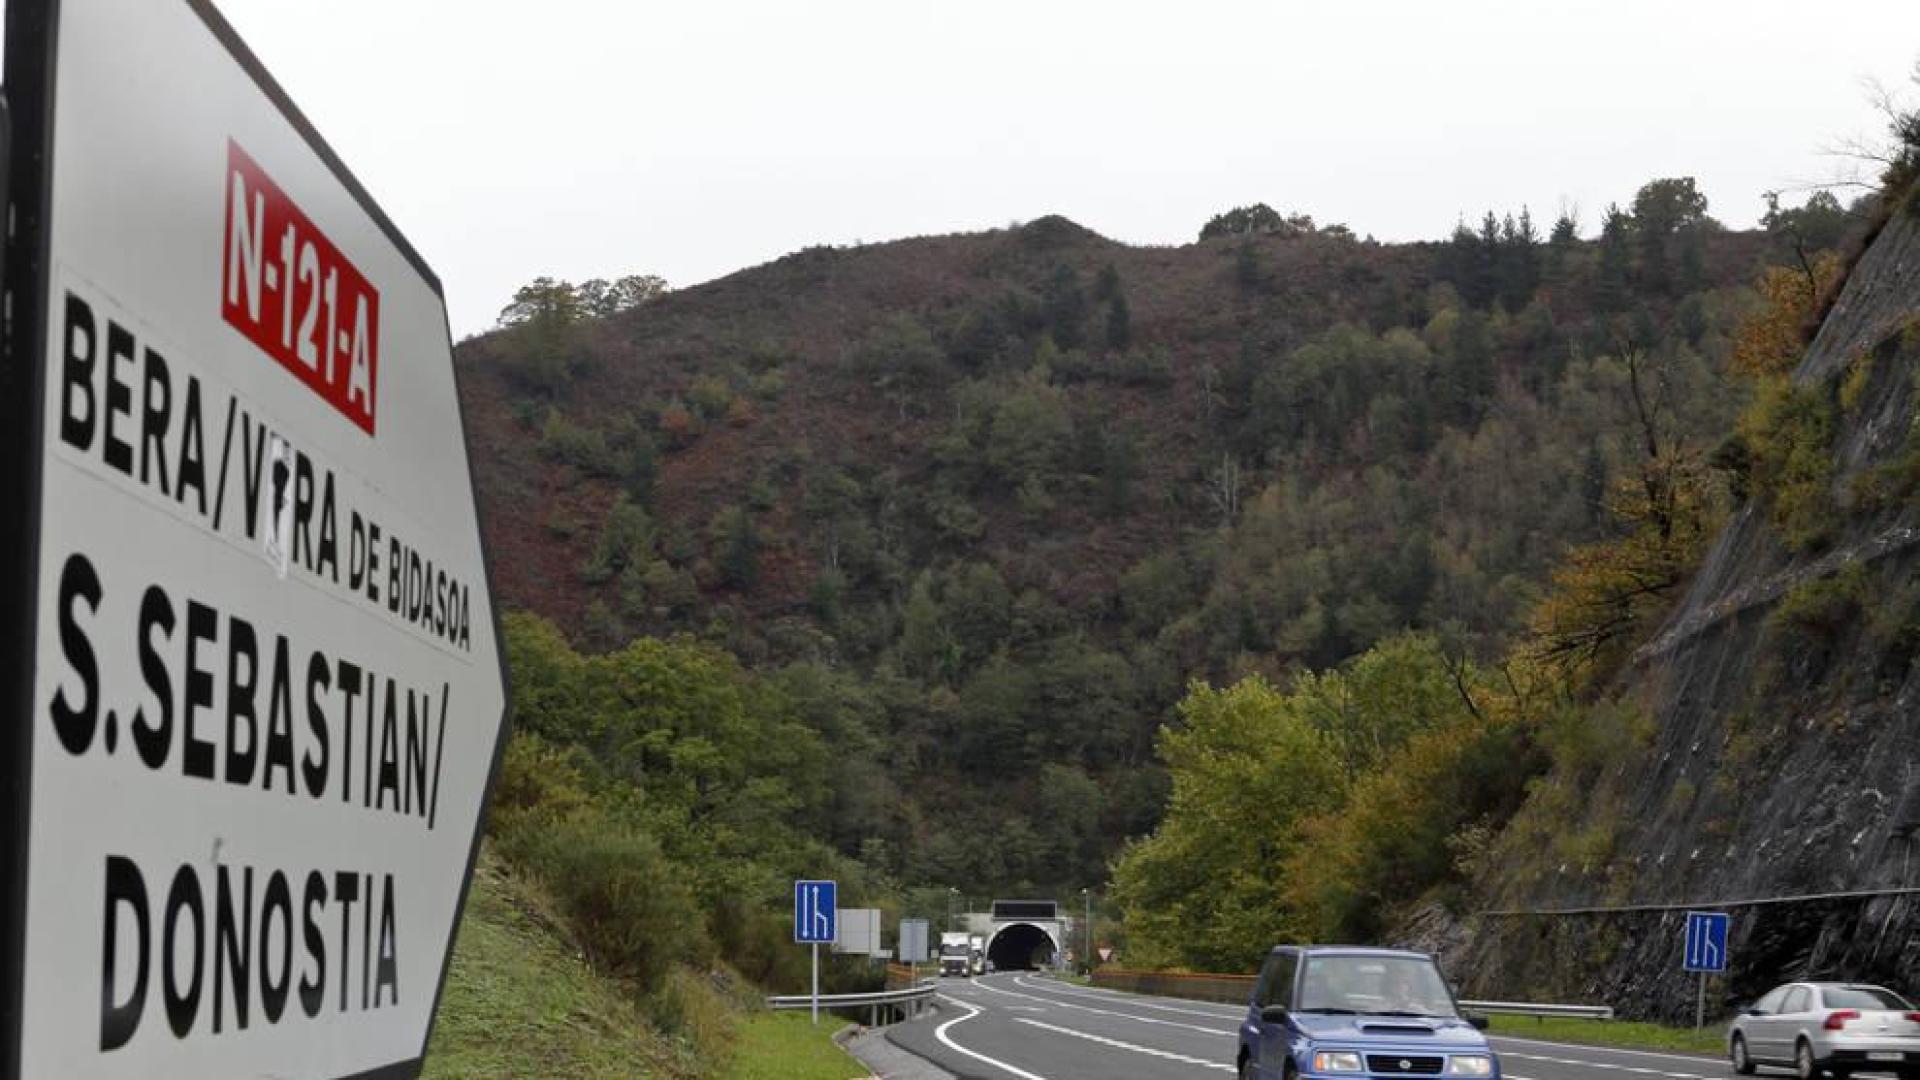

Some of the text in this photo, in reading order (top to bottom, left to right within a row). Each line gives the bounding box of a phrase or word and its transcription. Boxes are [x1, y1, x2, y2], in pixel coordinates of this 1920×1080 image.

[228, 170, 373, 416] N-121-A
[60, 289, 470, 652] BERA/VRA DE BIDASOA
[49, 552, 450, 831] S.SEBASTIAN/
[100, 853, 399, 1053] DONOSTIA
